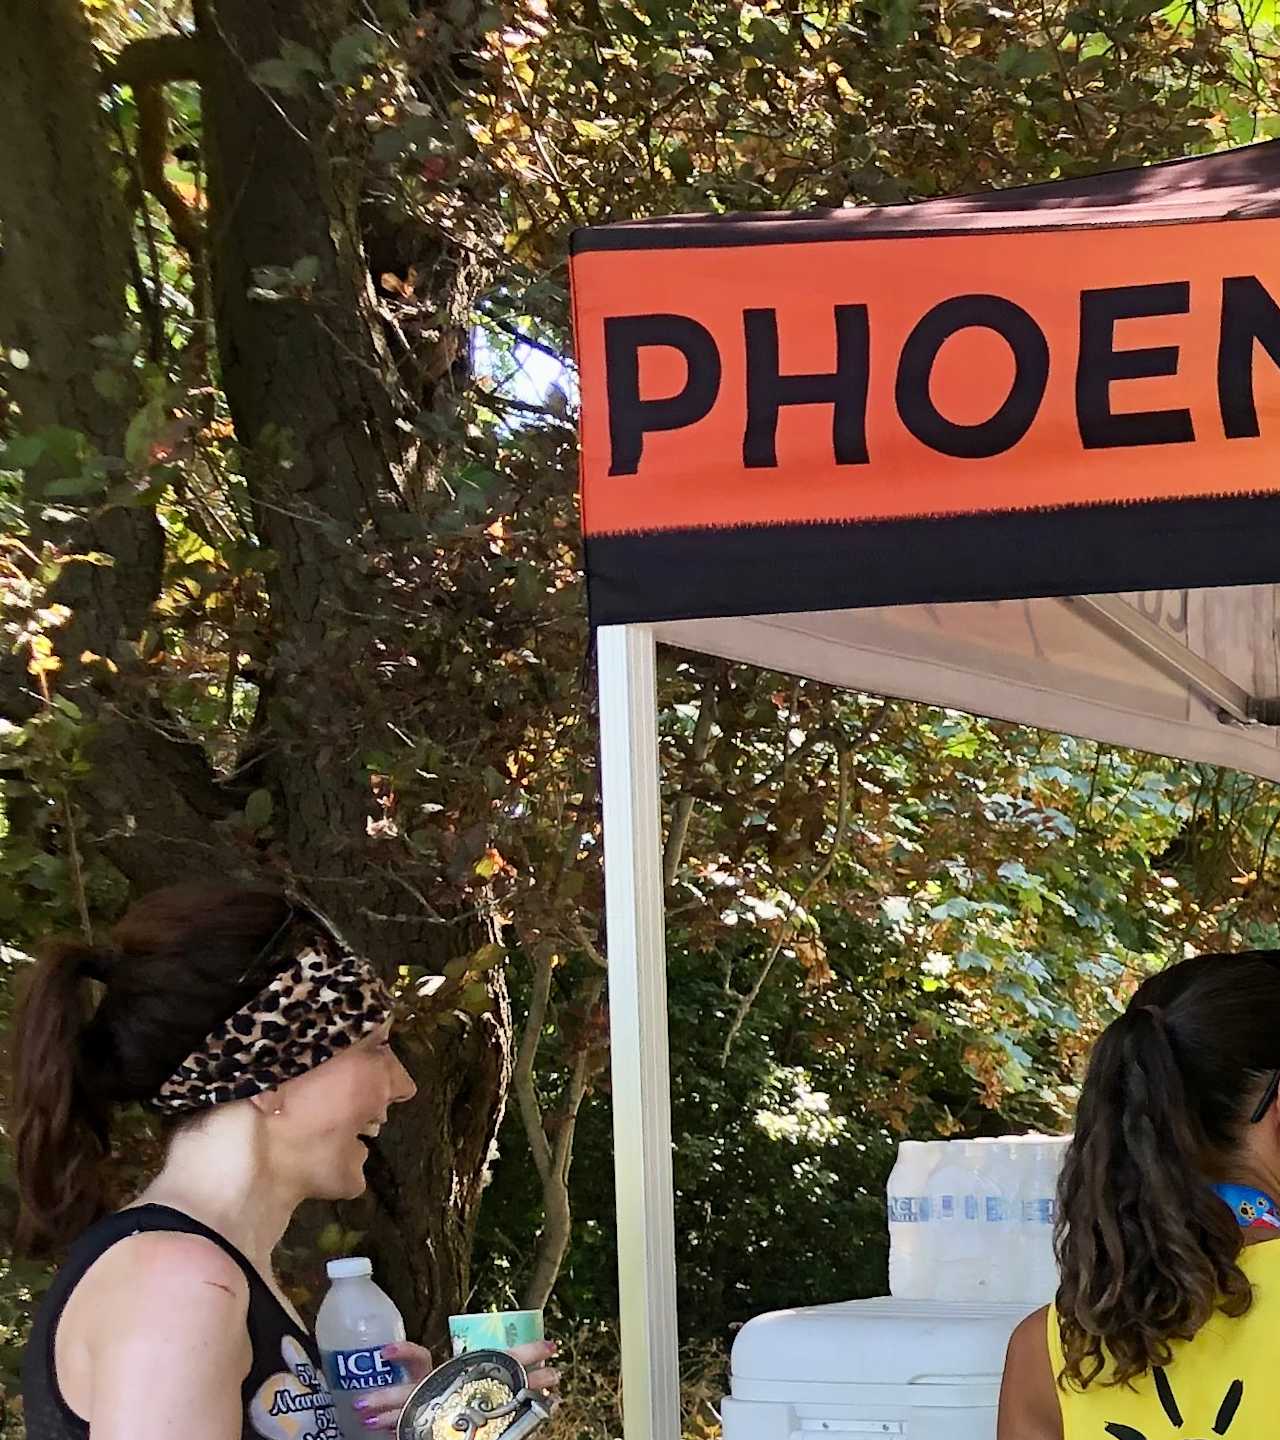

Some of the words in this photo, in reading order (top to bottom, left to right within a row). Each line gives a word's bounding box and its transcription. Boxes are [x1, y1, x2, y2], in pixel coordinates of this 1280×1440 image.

[337, 1350, 391, 1377] ICE
[339, 1374, 394, 1390] VALLEY
[315, 1408, 337, 1433] 52
